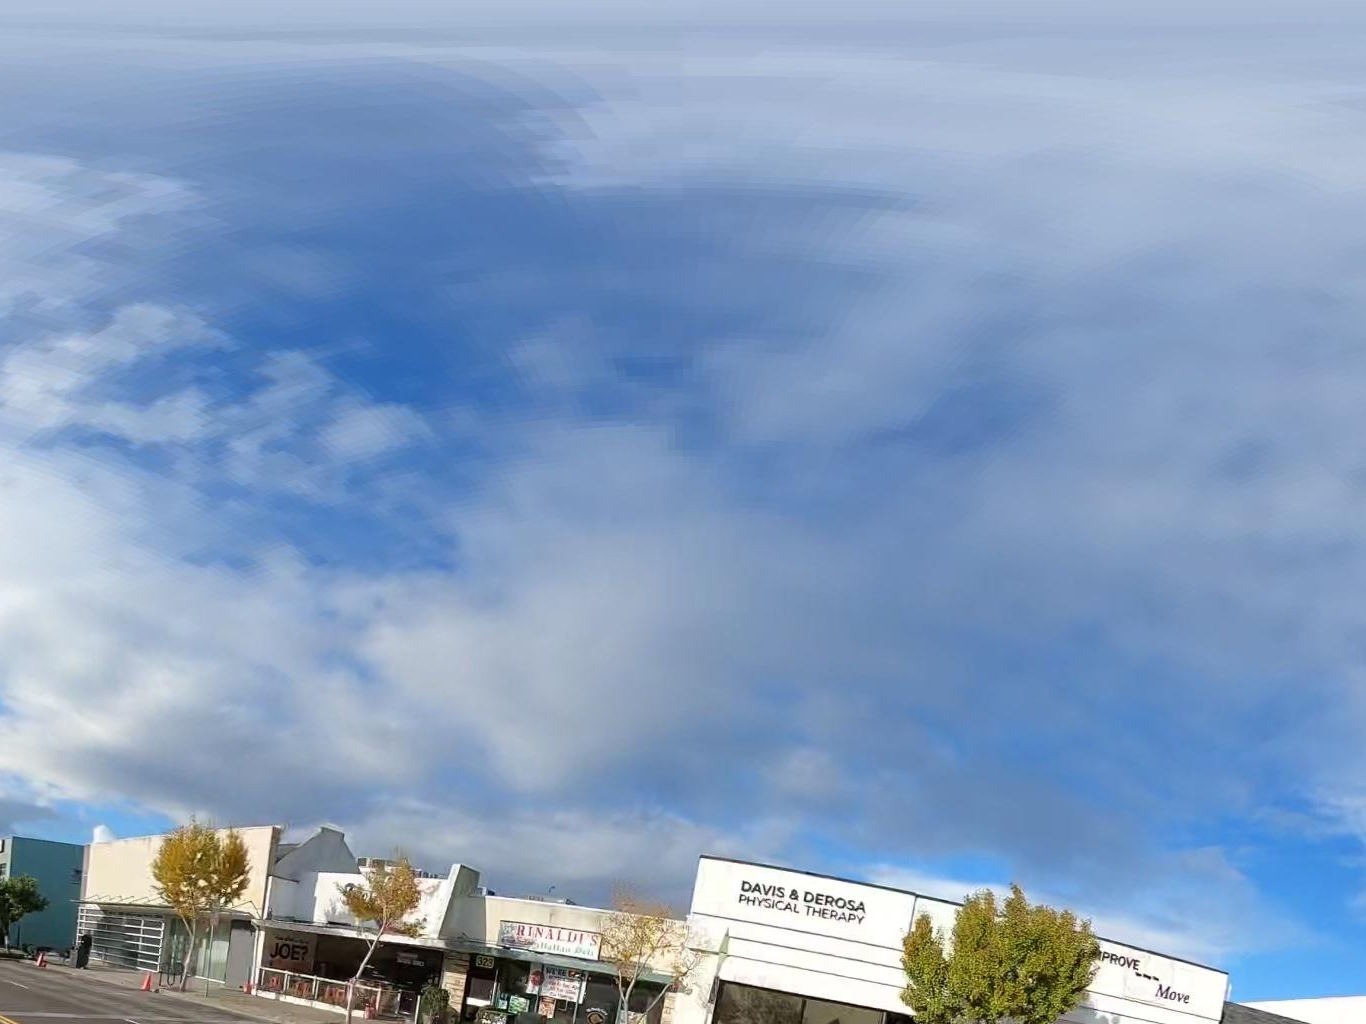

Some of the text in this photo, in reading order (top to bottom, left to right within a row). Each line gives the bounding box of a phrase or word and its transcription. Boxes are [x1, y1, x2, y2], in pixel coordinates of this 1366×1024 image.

[740, 880, 867, 913] DAVIS & DEROSA
[738, 893, 865, 925] PHYSICAL THERAPY
[515, 924, 598, 945] RINALDI'S
[269, 943, 308, 961] JOE?
[1155, 984, 1190, 1004] Move
